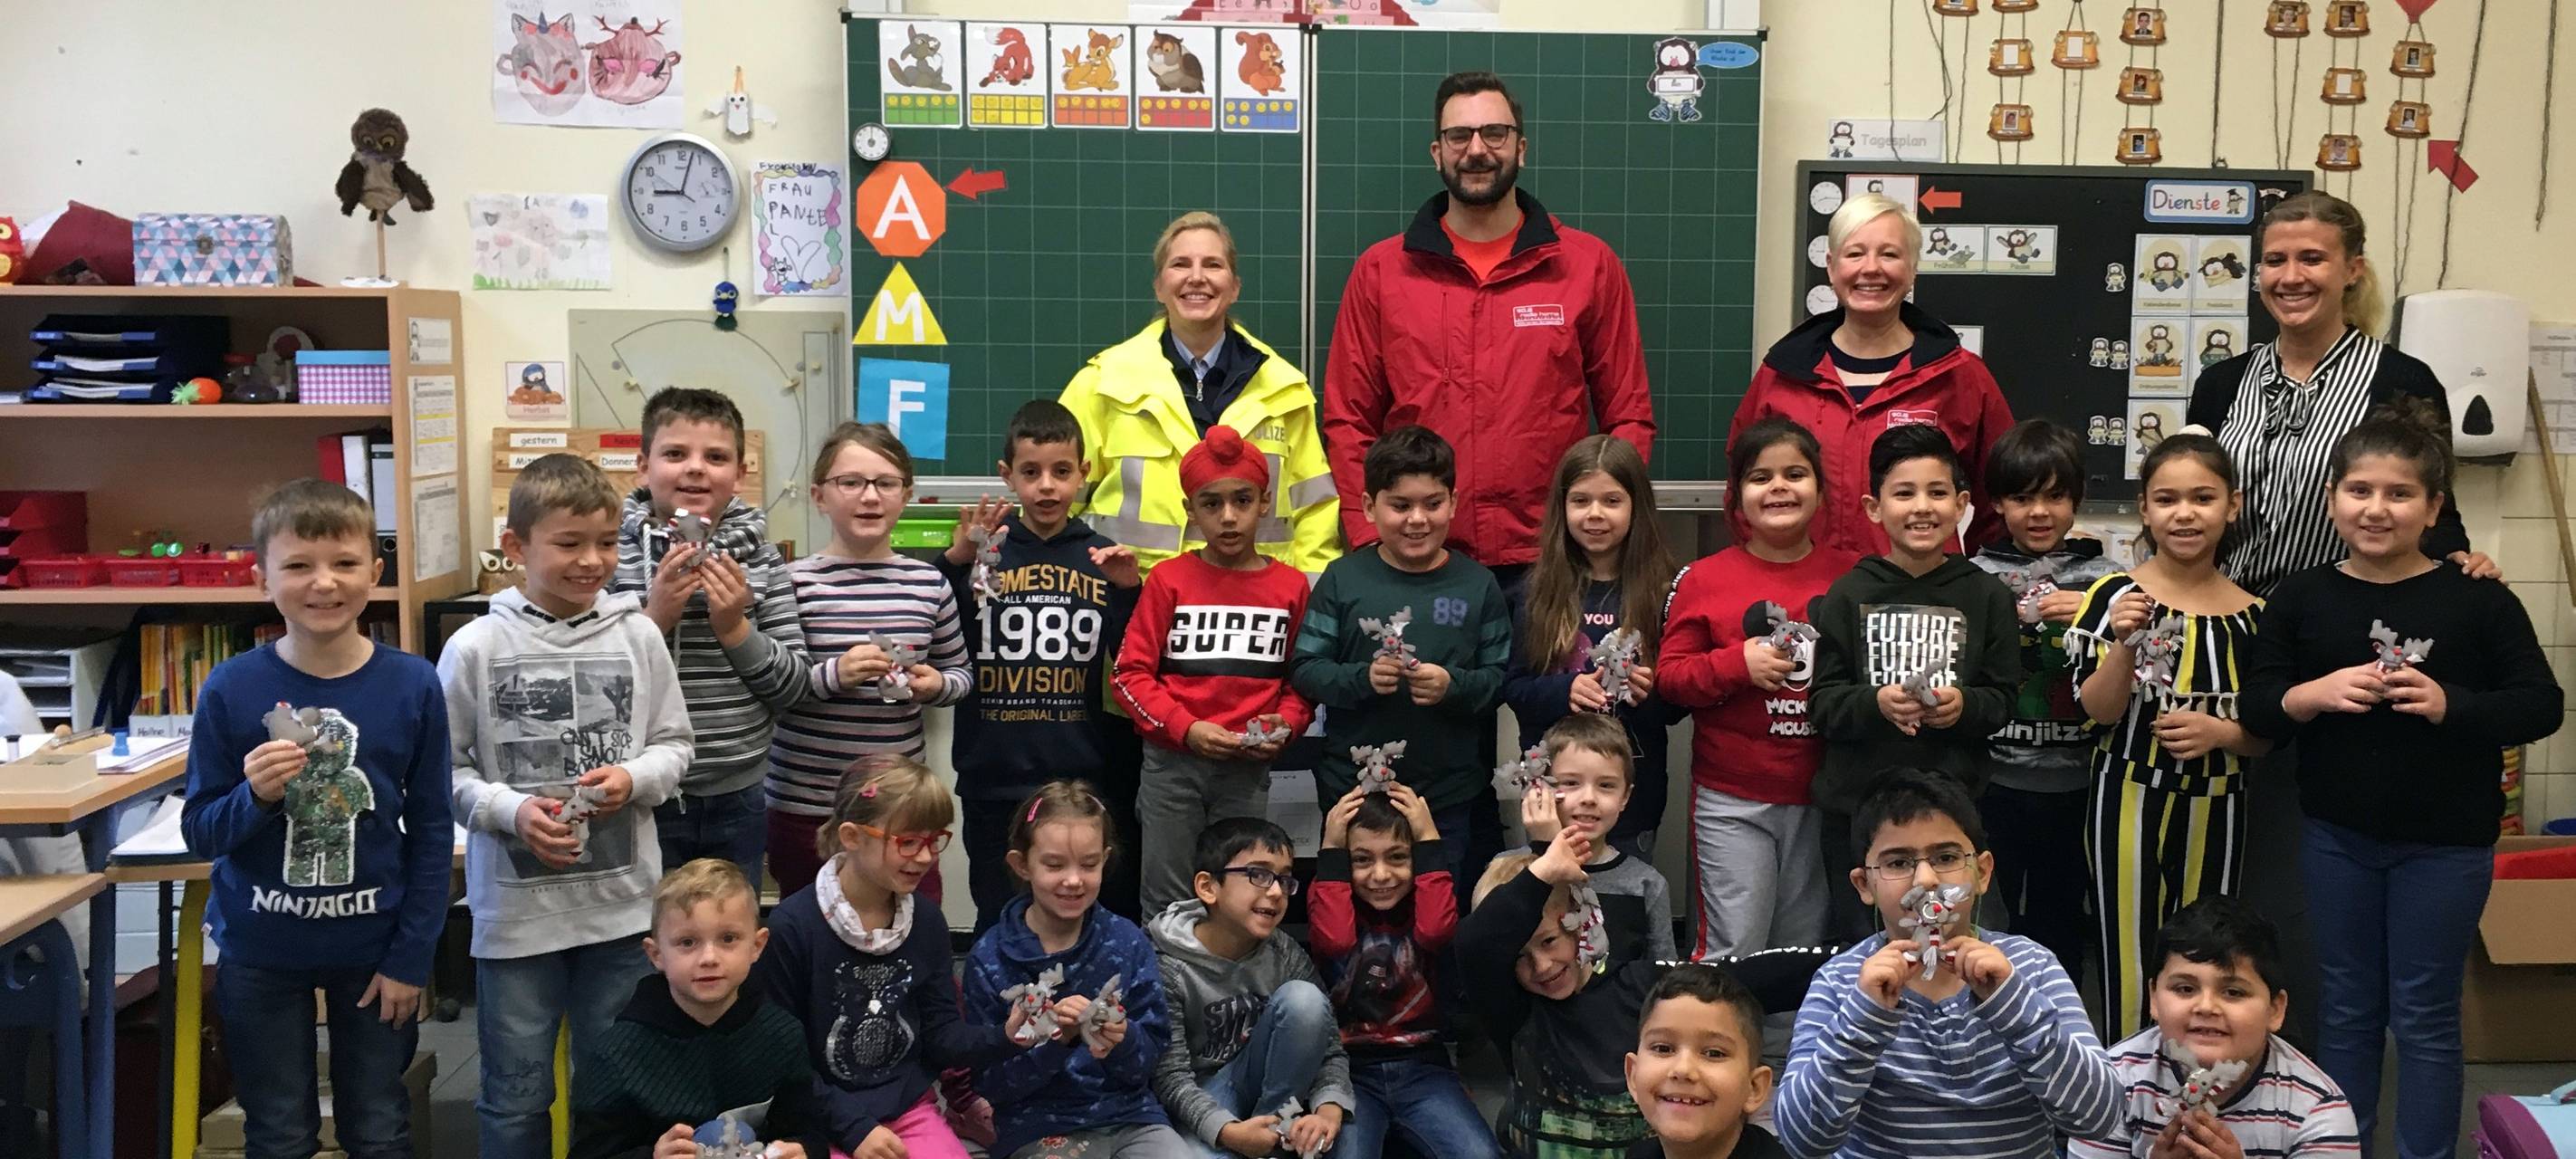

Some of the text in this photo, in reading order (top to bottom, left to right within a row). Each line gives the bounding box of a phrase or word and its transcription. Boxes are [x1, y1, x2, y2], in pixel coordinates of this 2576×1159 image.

[1861, 133, 1927, 149] Tagesplan
[657, 154, 666, 165] 11
[676, 150, 687, 162] 12
[645, 167, 655, 178] 10
[712, 168, 719, 178] 2
[768, 182, 812, 197] FRAU
[2152, 189, 2221, 210] Dienste
[646, 204, 655, 216] 8
[714, 204, 722, 215] 4
[872, 174, 931, 240] A
[664, 216, 670, 227] 7
[680, 220, 688, 232] 6
[699, 216, 707, 227] 5
[875, 289, 925, 342] M
[887, 378, 925, 441] F
[520, 437, 558, 447] gestern
[1003, 595, 1072, 605] ALL AMERICAN
[1585, 613, 1614, 626] YOU
[974, 605, 1103, 663] 1989
[1170, 611, 1289, 656] SUPER
[1866, 612, 1961, 647] FUTURE
[979, 666, 1088, 694] DIVISION
[1765, 697, 1808, 714] MICK
[1000, 708, 1055, 722] ORIGINAL
[248, 885, 383, 919] NINJAGO
